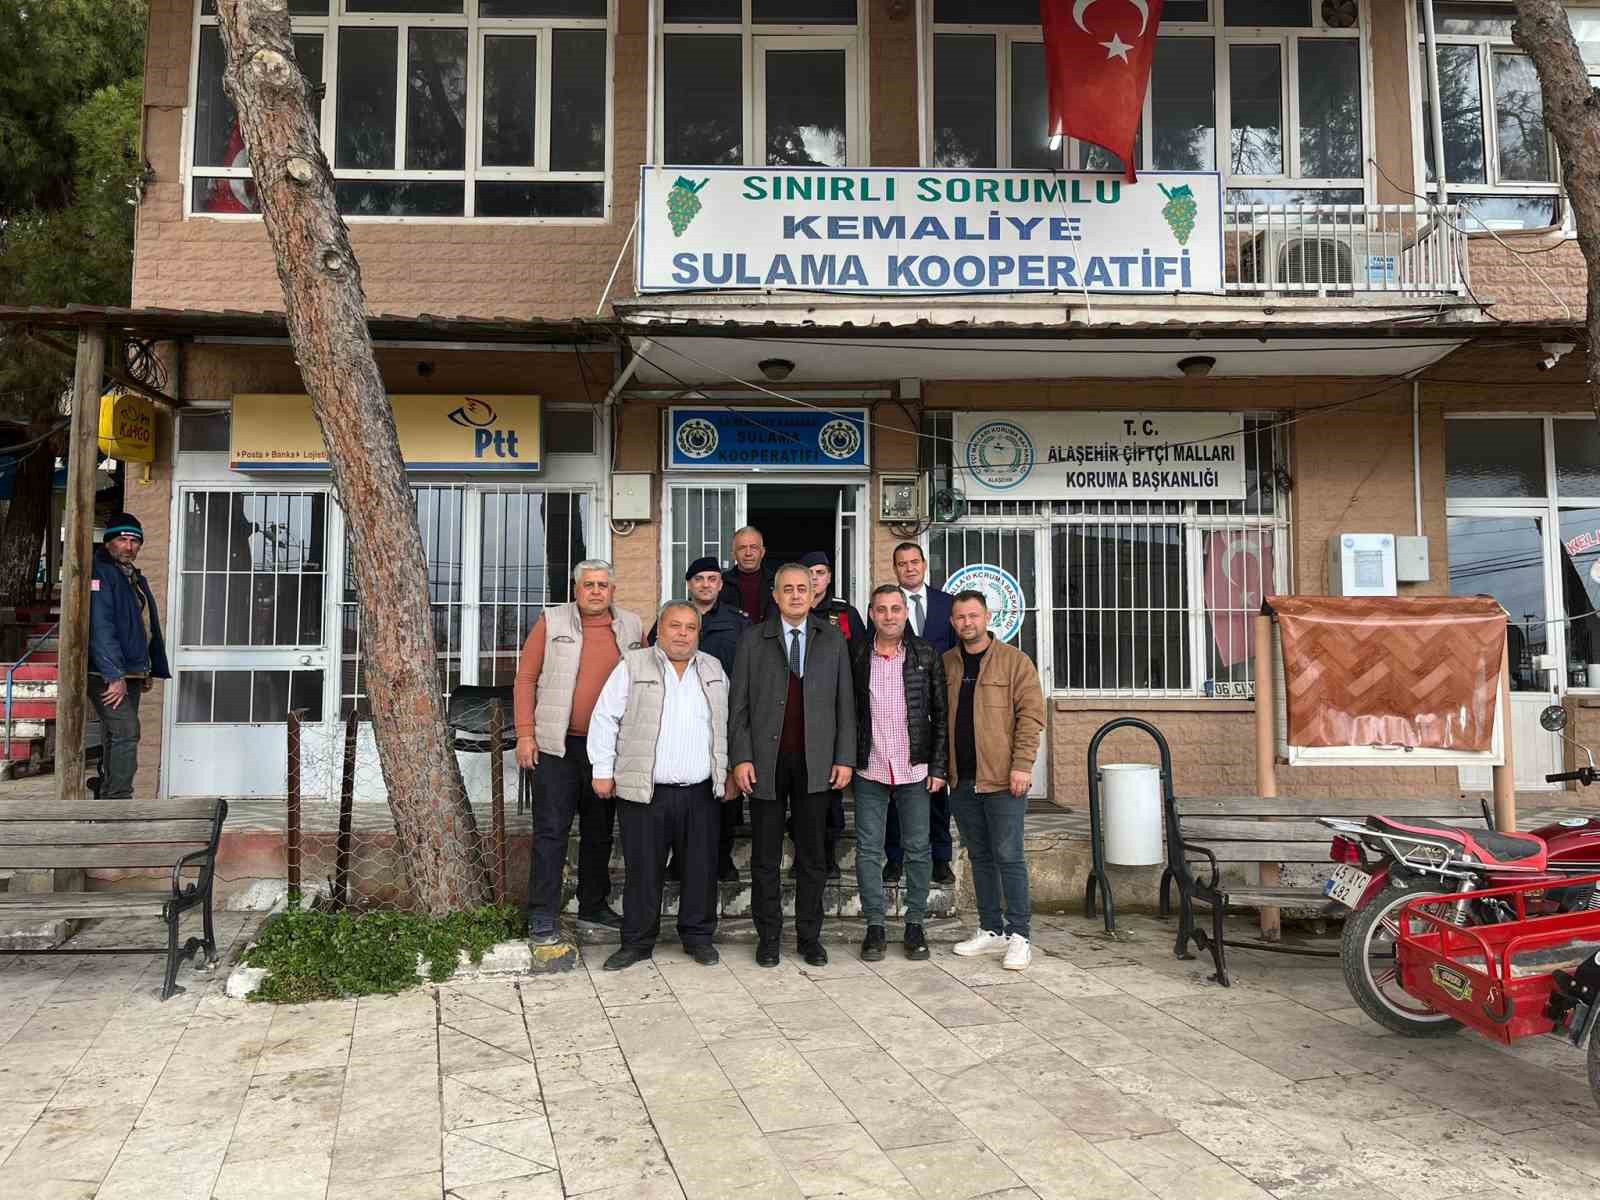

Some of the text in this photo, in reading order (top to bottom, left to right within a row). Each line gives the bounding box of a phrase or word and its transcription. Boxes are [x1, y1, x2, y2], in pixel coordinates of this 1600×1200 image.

[742, 175, 1121, 204] SINIRLI SORUMLU
[783, 210, 1082, 241] KEMALİYE
[671, 248, 1193, 289] SULAMA KOOPERATİFİ
[1123, 419, 1159, 436] T. C.
[241, 449, 329, 461] Posta Banka Lojisti
[475, 428, 519, 458] Ptt
[1048, 440, 1235, 466] ALAŞEHİR ÇİFTÇİ MALLARI
[1066, 466, 1219, 492] KORUMA BAŞKANLIĞI
[1215, 683, 1230, 695] 06
